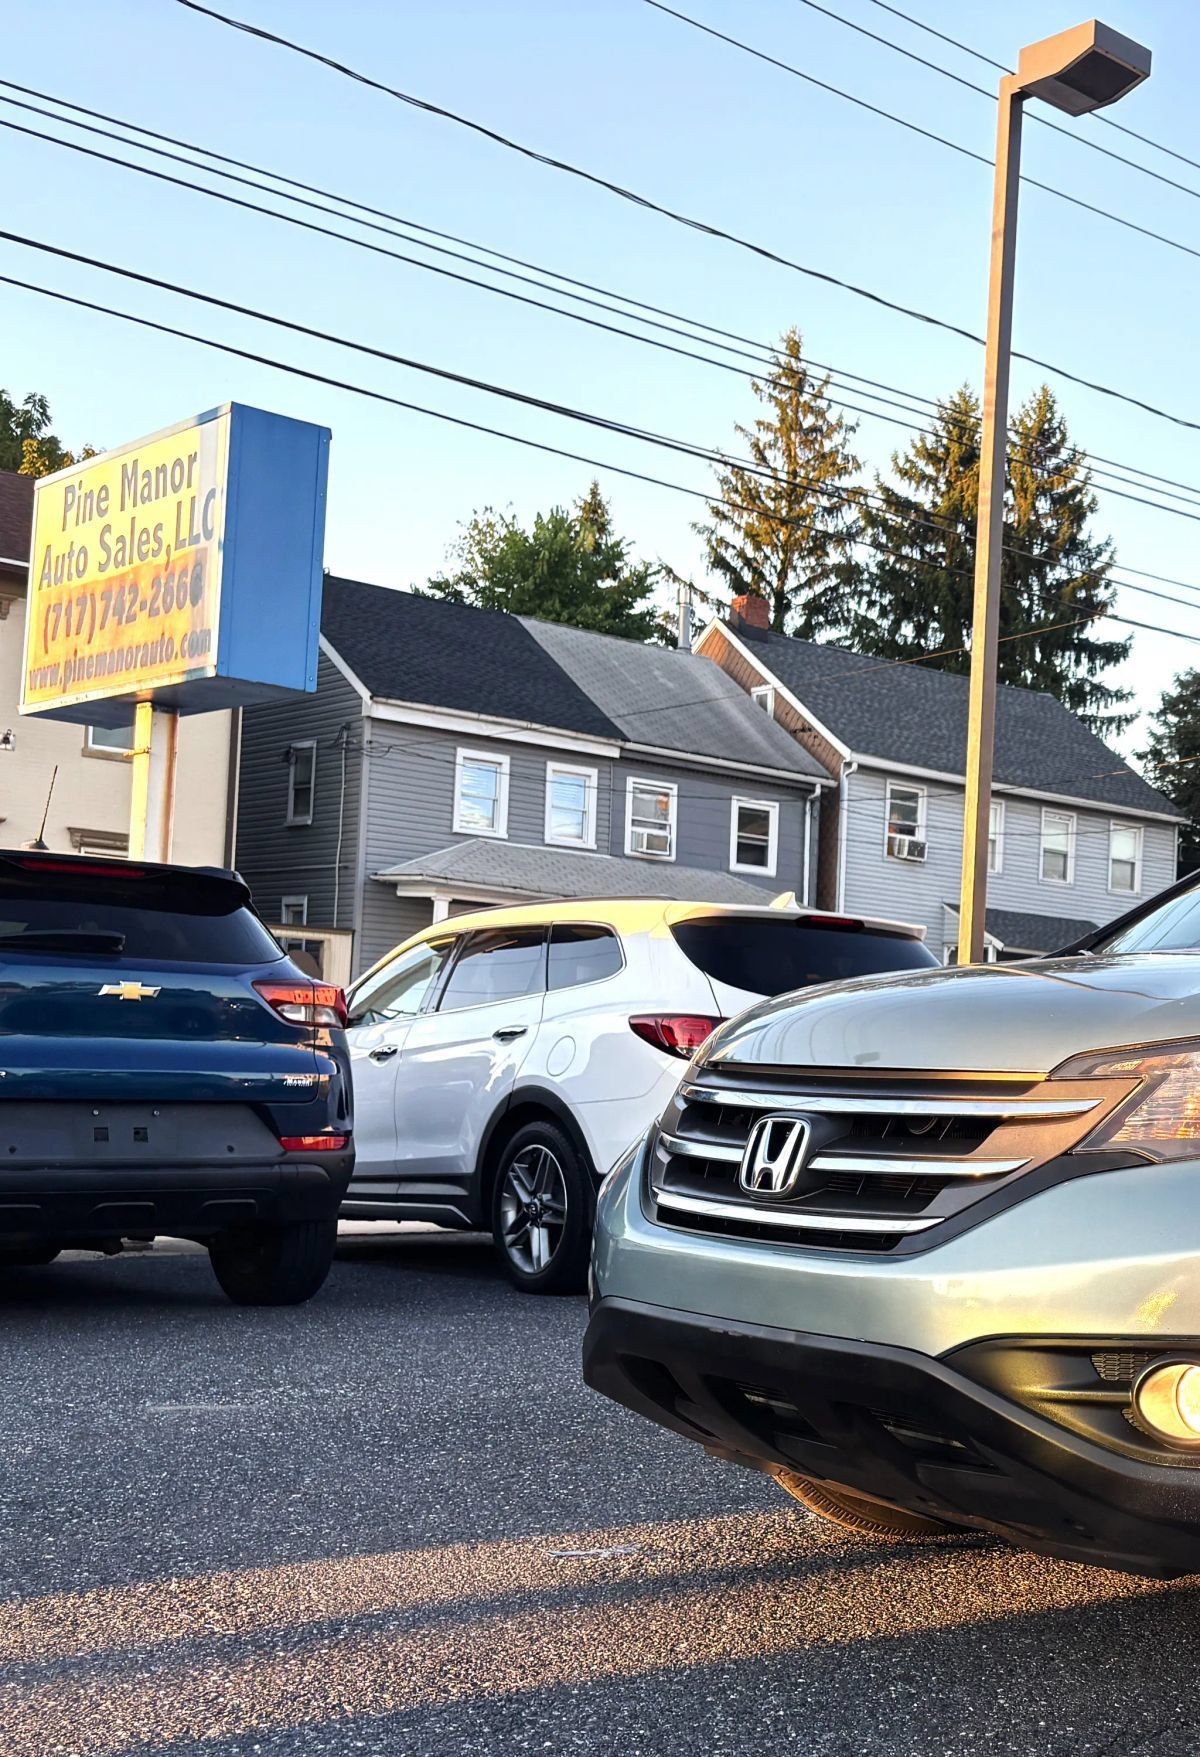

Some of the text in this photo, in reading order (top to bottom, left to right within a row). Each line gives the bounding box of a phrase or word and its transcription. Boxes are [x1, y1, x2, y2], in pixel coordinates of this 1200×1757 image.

[62, 451, 198, 532] Pine Manor
[39, 541, 89, 591] Auto
[29, 628, 212, 694] www.pinemanorauto.com
